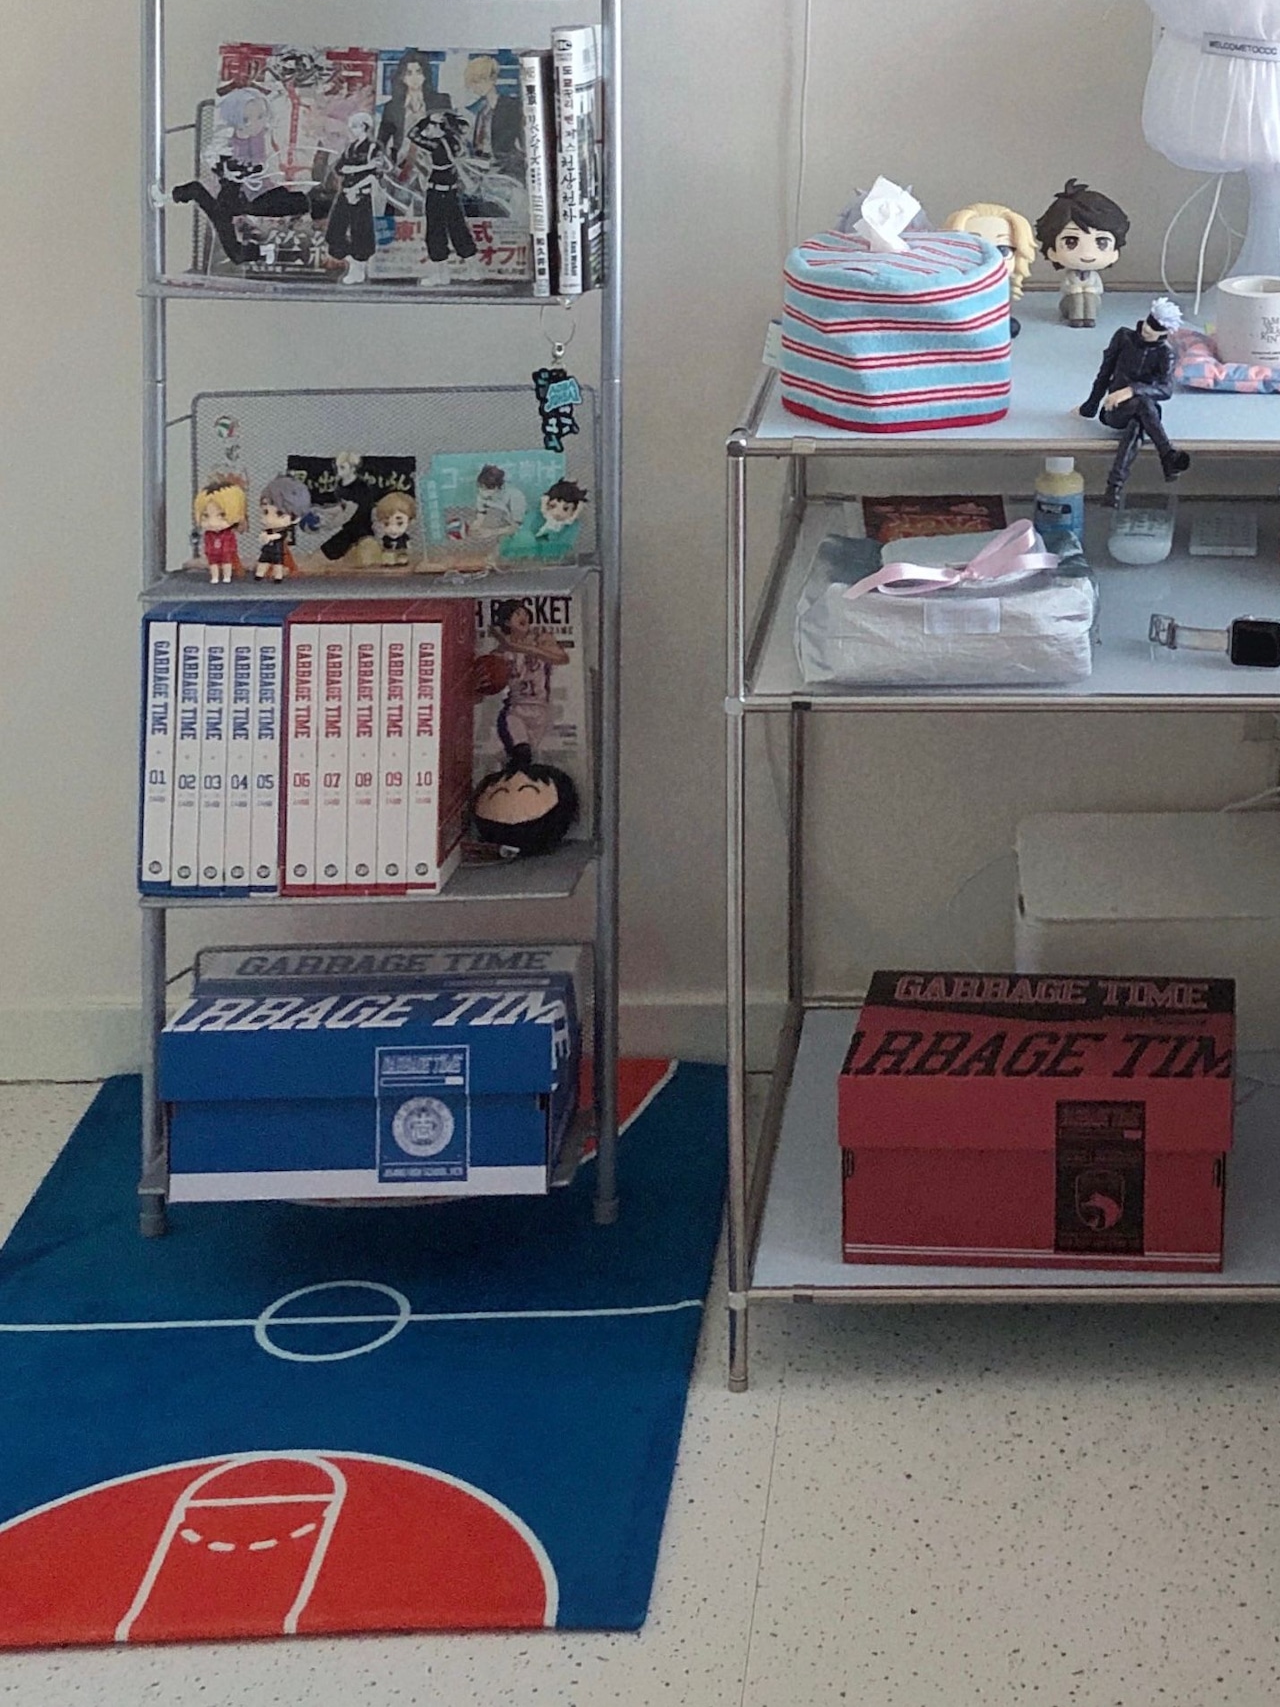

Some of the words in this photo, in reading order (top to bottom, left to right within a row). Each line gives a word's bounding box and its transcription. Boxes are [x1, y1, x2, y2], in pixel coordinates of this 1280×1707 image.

[490, 596, 573, 628] BSKET
[151, 702, 168, 735] TIME
[180, 708, 197, 740] TIME
[205, 708, 222, 740] TIME
[232, 708, 249, 740] TIME
[258, 707, 274, 740] TIME
[294, 705, 311, 738] TIME
[325, 705, 341, 738] TIME
[356, 705, 373, 738] TIME
[386, 704, 403, 737] TIME
[416, 704, 433, 737] TIME
[149, 770, 166, 785] 01
[178, 774, 196, 789] 02
[204, 775, 222, 790] 03
[231, 775, 248, 789] 04
[256, 774, 274, 789] 05
[293, 773, 310, 787] 06
[323, 773, 341, 788] 07
[355, 772, 372, 787] 08
[385, 772, 402, 787] 09
[416, 771, 433, 786] 10
[443, 950, 552, 972] TIME
[1098, 979, 1210, 1009] TIME
